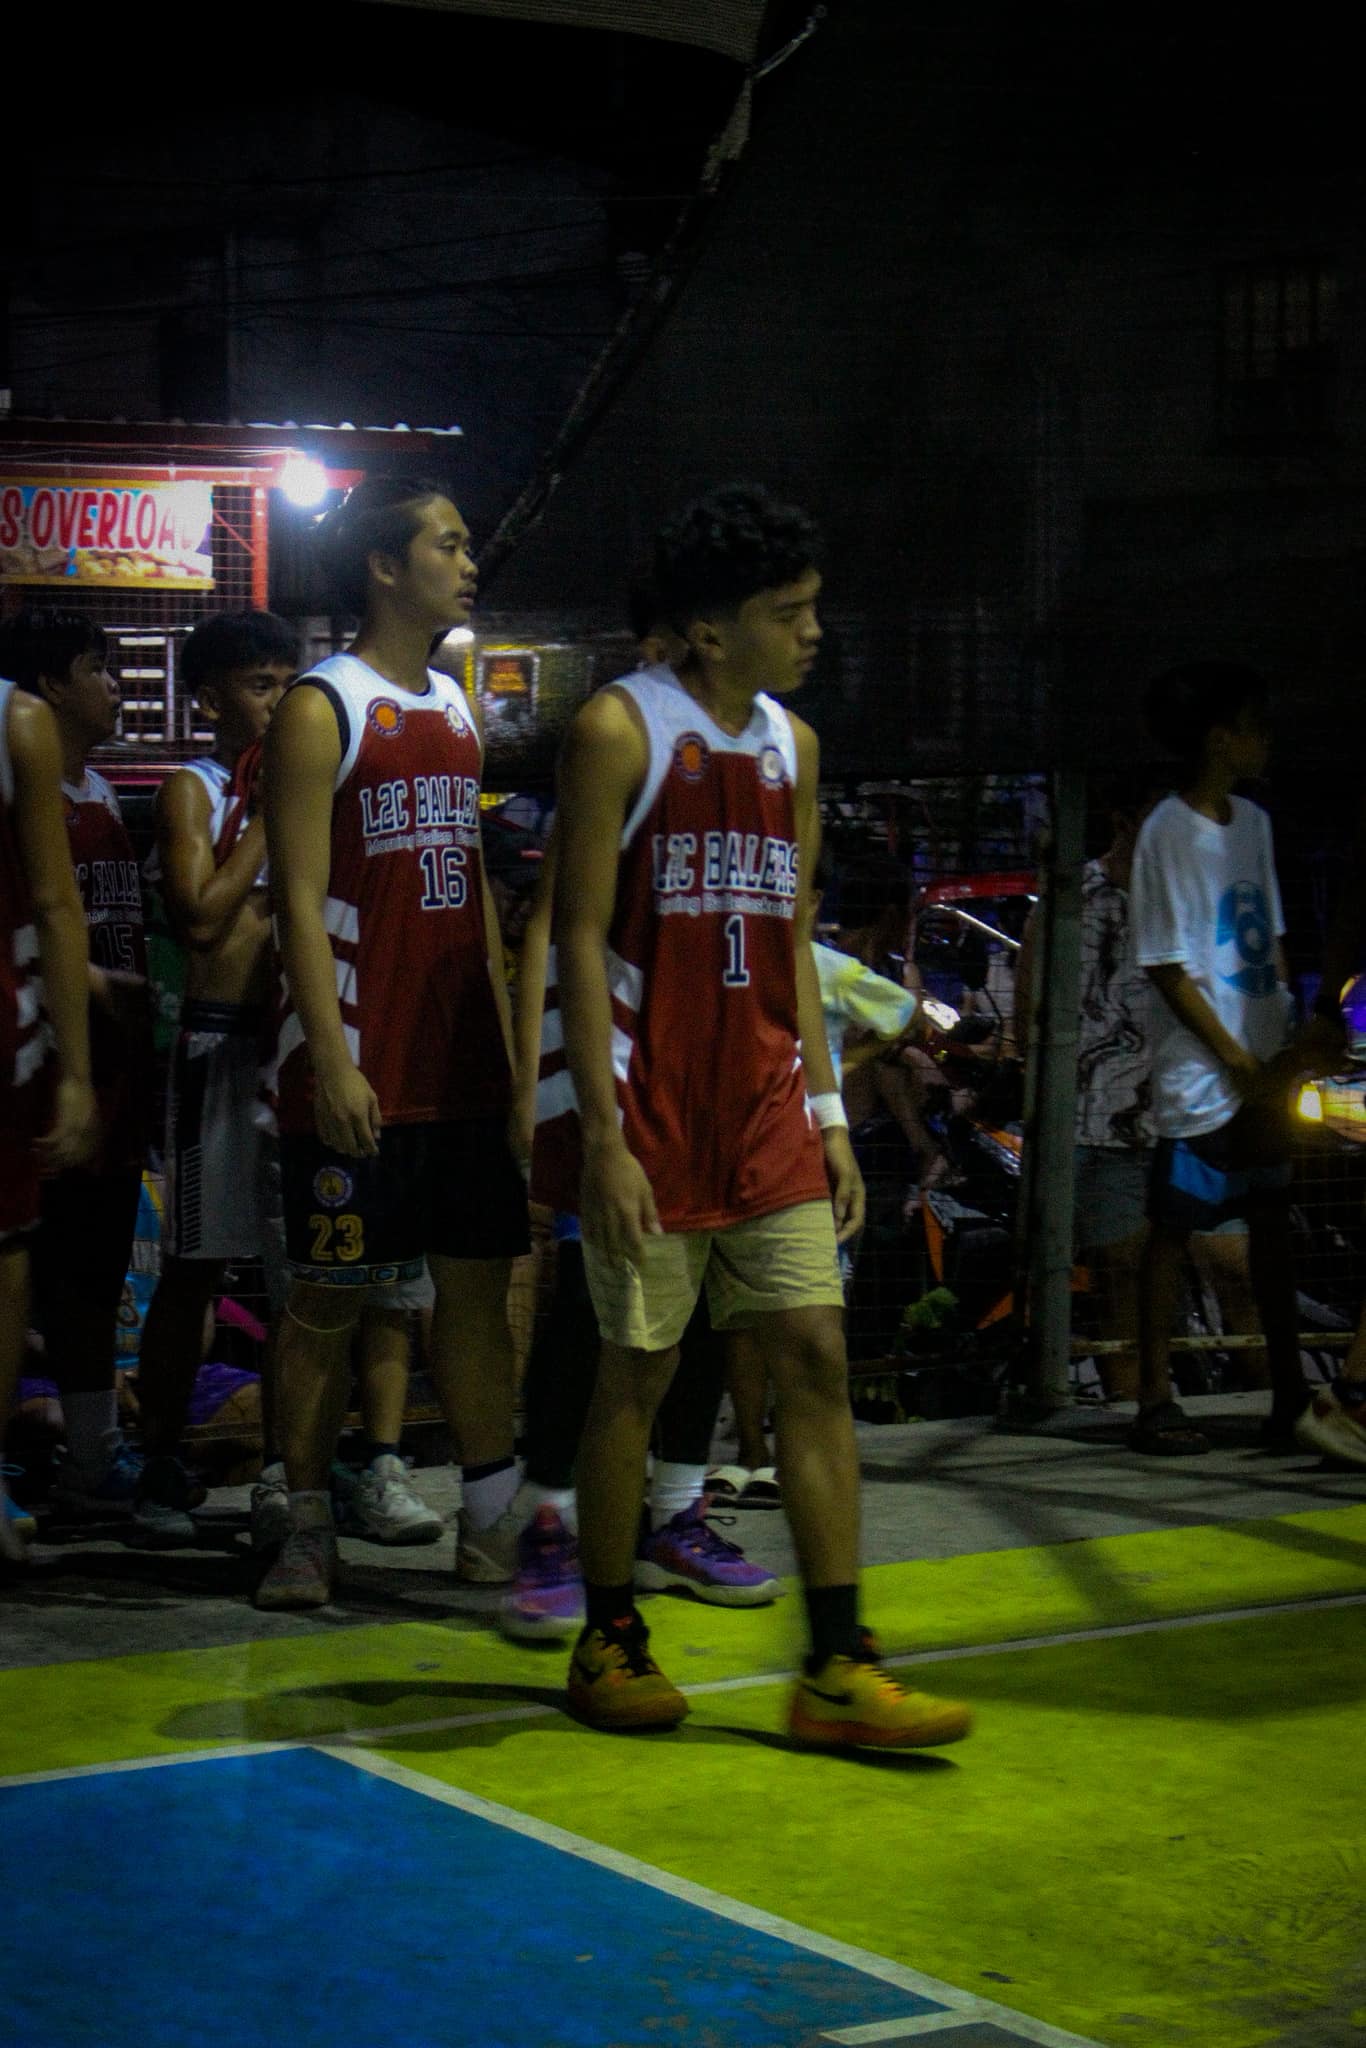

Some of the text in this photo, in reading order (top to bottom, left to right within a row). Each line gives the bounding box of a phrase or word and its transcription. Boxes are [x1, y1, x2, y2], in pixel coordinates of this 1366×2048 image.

[360, 779, 409, 837] L2C
[420, 847, 467, 910] 16
[96, 924, 137, 976] 15
[722, 914, 750, 988] 1
[307, 1213, 365, 1262] 23
